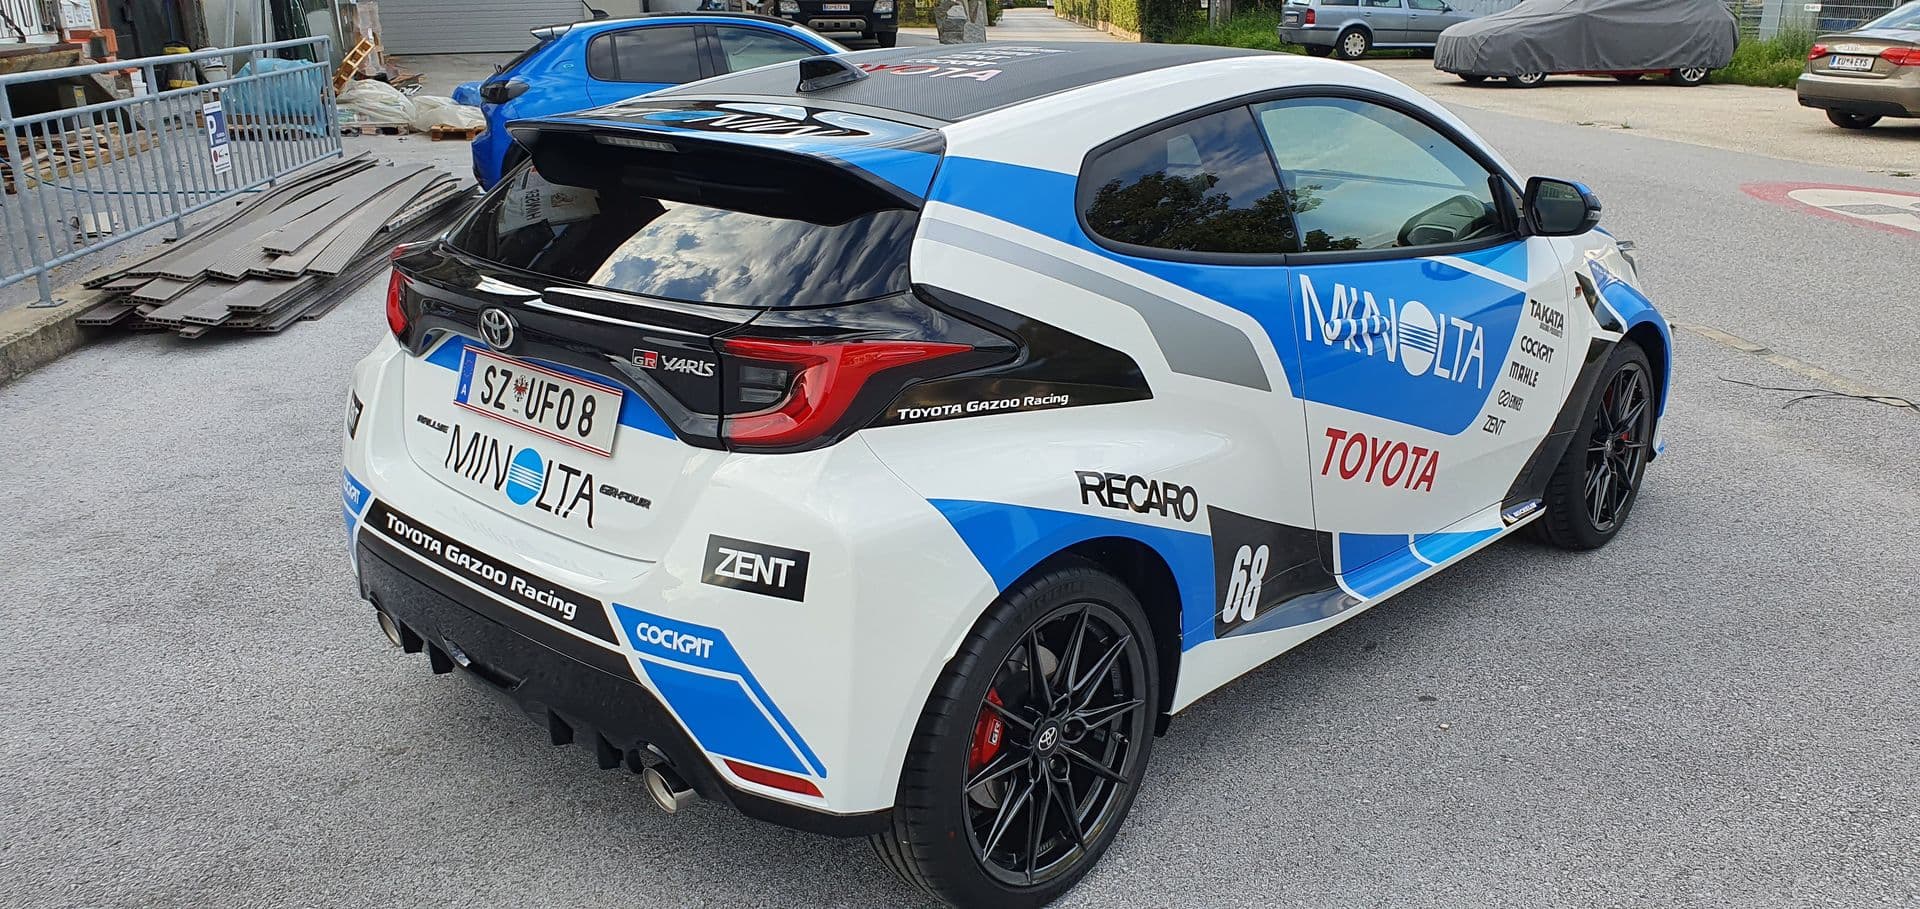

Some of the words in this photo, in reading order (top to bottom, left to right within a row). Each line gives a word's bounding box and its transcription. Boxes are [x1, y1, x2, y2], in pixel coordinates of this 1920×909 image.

[854, 63, 1003, 82] YOTA
[206, 114, 217, 146] P
[1530, 299, 1564, 331] TAKATA
[1299, 273, 1485, 390] MINOLTA
[1520, 335, 1554, 364] COCKPIT
[634, 355, 657, 368] GR
[661, 355, 716, 378] YARIS
[1508, 361, 1539, 388] MAHLE
[460, 383, 468, 396] A
[480, 364, 513, 411] SZ
[897, 403, 963, 421] TOYOTA
[966, 397, 1020, 413] GAZOO
[1023, 393, 1070, 407] Racing
[417, 414, 449, 434] RALLYE
[1482, 414, 1506, 436] ZENT
[1321, 427, 1440, 492] TOYOTA
[445, 423, 594, 529] MINOLTA
[1075, 470, 1199, 522] RECARO
[386, 512, 442, 555] TOYOTA
[445, 544, 508, 587] GAZOO
[510, 575, 578, 621] Racing
[714, 547, 796, 588] ZENT
[1222, 544, 1270, 624] 68
[636, 622, 714, 659] COCKPIT
